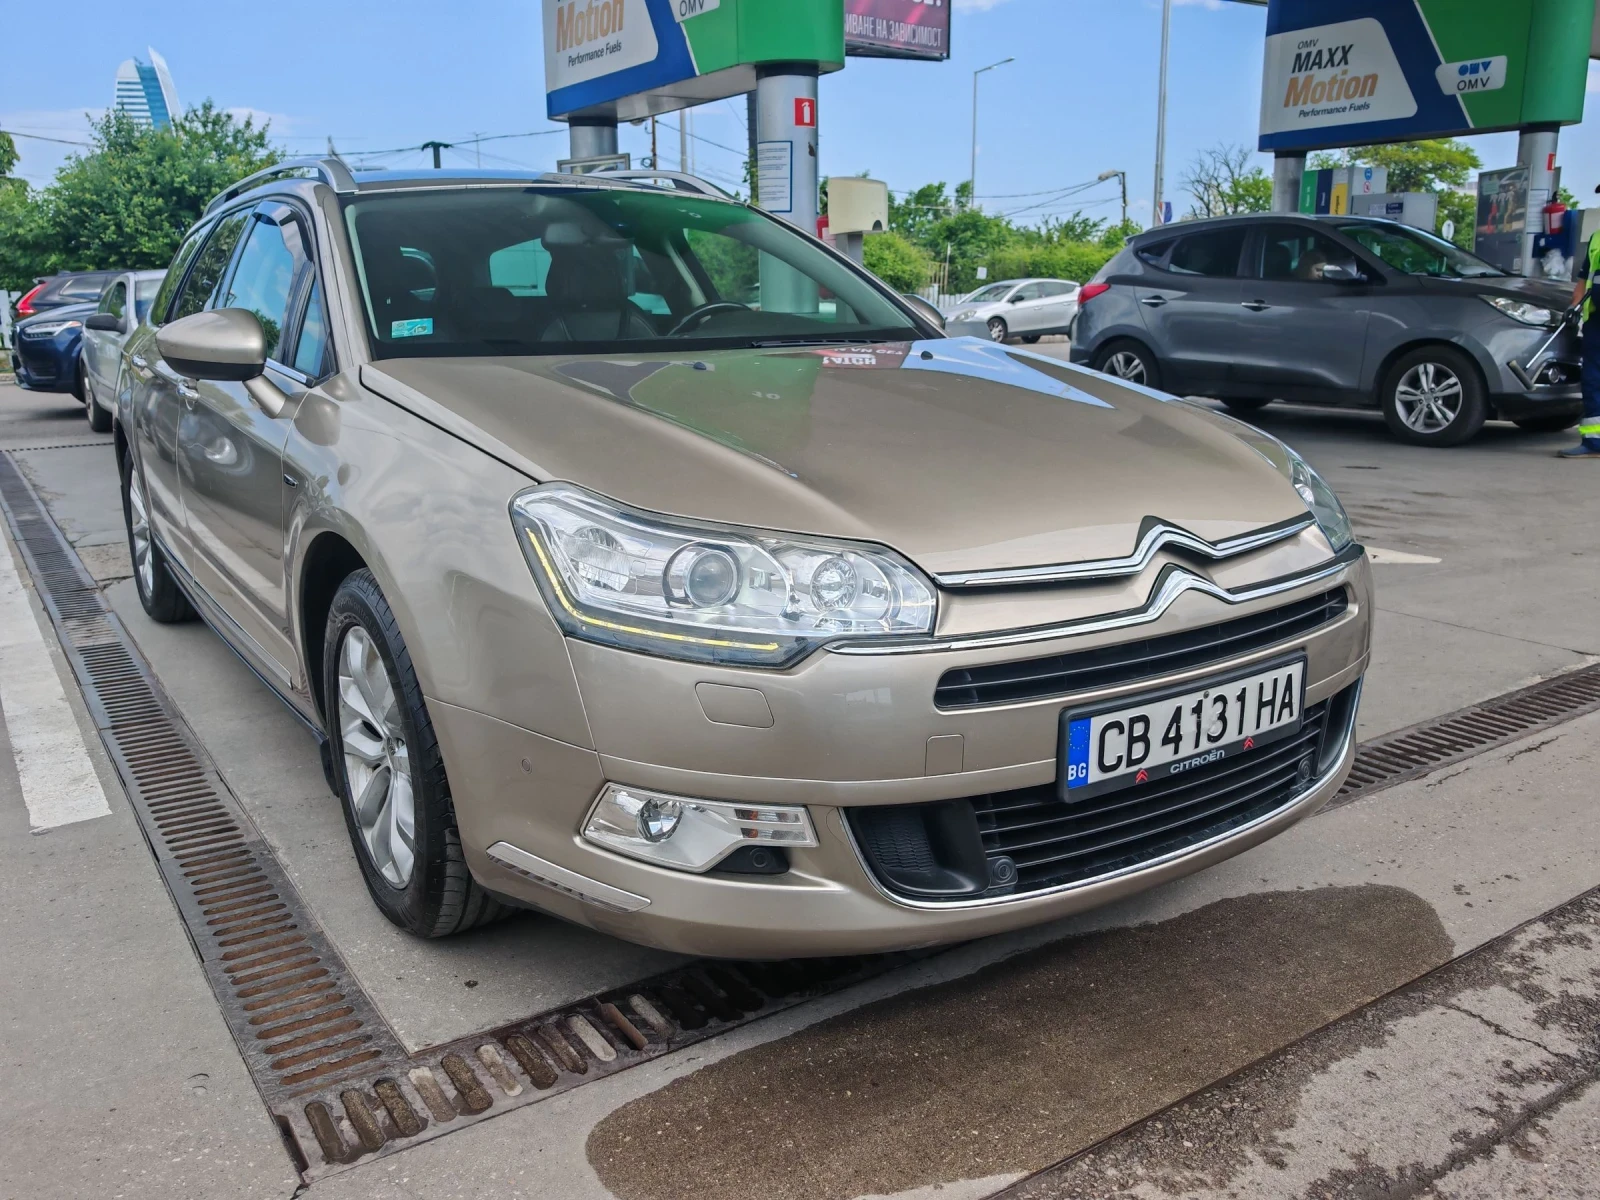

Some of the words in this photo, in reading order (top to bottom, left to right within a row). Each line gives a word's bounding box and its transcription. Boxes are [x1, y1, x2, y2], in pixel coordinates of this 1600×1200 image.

[679, 0, 705, 17] OMV
[556, 0, 625, 53] Motion
[875, 18, 888, 39] НА
[889, 20, 942, 47] ЗАВИСИМОСТ
[568, 48, 605, 68] Performance
[605, 40, 622, 56] Fuels
[1297, 38, 1319, 50] OMV
[1291, 44, 1354, 74] MAXX
[1283, 68, 1379, 108] Motion
[1457, 76, 1490, 91] OMV
[1298, 104, 1347, 118] Performance
[1348, 101, 1371, 113] Fuels
[1097, 713, 1151, 774] CB
[1161, 686, 1247, 756] 4131
[1255, 672, 1294, 731] HA
[1067, 762, 1087, 781] BG
